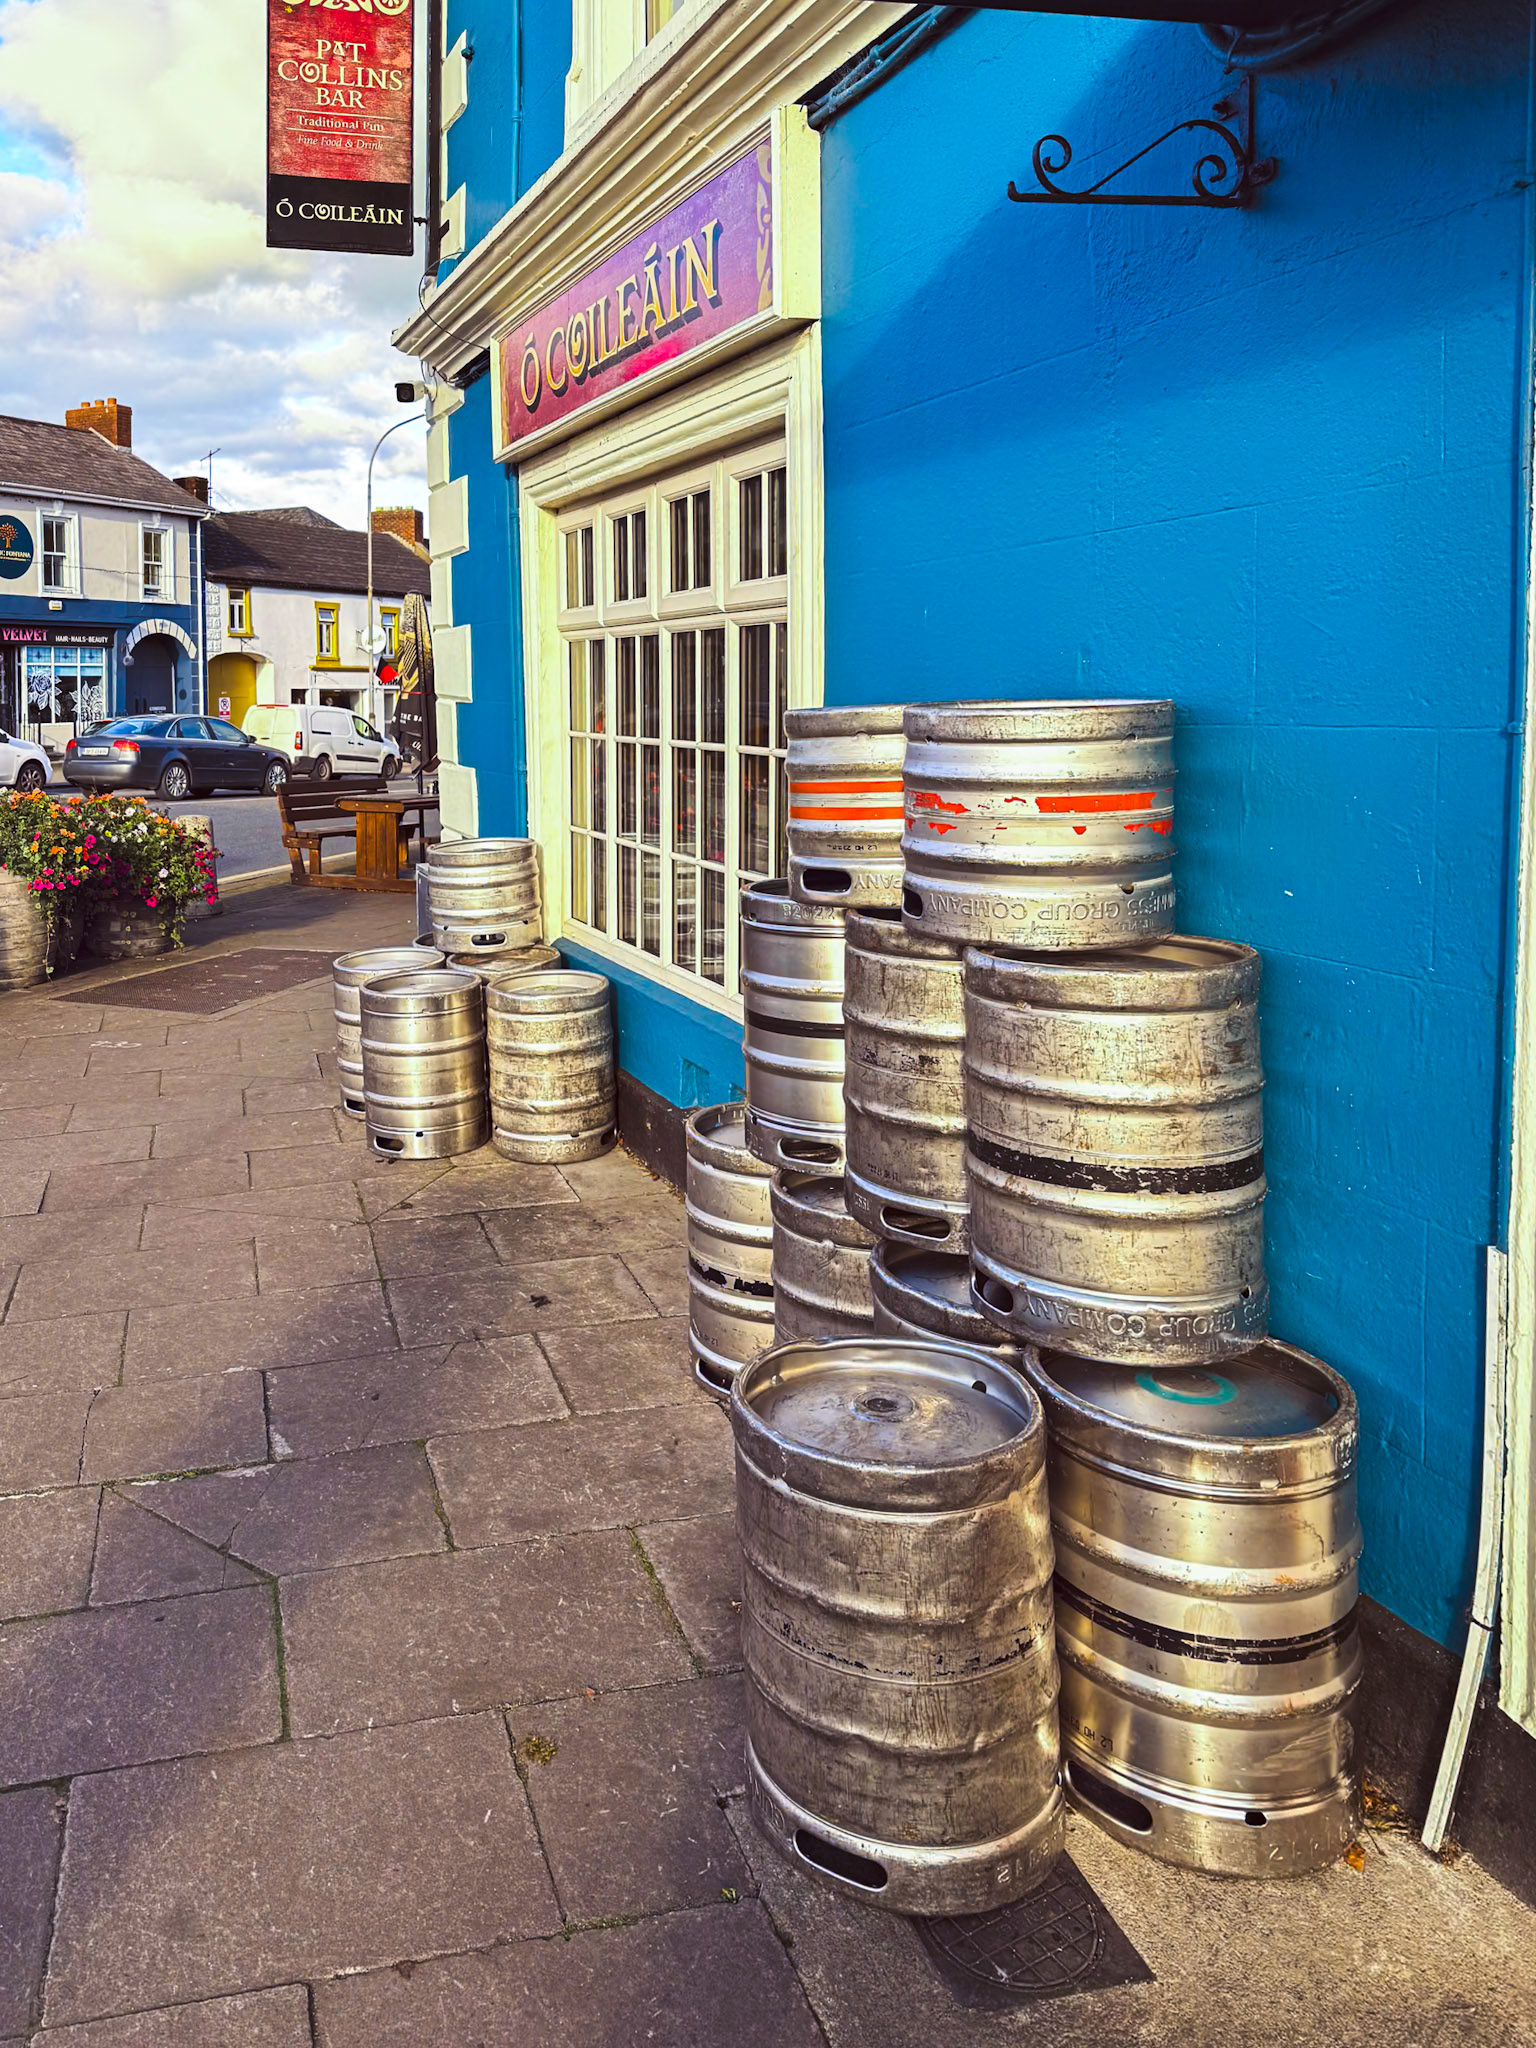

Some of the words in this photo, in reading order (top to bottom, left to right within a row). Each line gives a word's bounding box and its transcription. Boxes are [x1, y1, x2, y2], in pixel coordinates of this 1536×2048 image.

[315, 39, 367, 64] PAT
[278, 60, 403, 91] COLLINS
[315, 88, 366, 109] BAR
[296, 115, 359, 130] Traditional
[298, 134, 318, 145] Fine
[321, 136, 342, 147] Food
[345, 140, 353, 148] &
[356, 140, 384, 151] Drink
[276, 198, 294, 218] Ó
[298, 203, 404, 225] COILEÁIN
[520, 332, 541, 408] Ó
[545, 218, 720, 390] COILEÁIN
[2, 628, 48, 641] VELVET
[854, 873, 903, 890] PANY
[929, 892, 1028, 920] COMPANY
[1037, 902, 1120, 921] GROUP
[1022, 1294, 1147, 1338] COMPANY
[1159, 1310, 1237, 1338] GROUP
